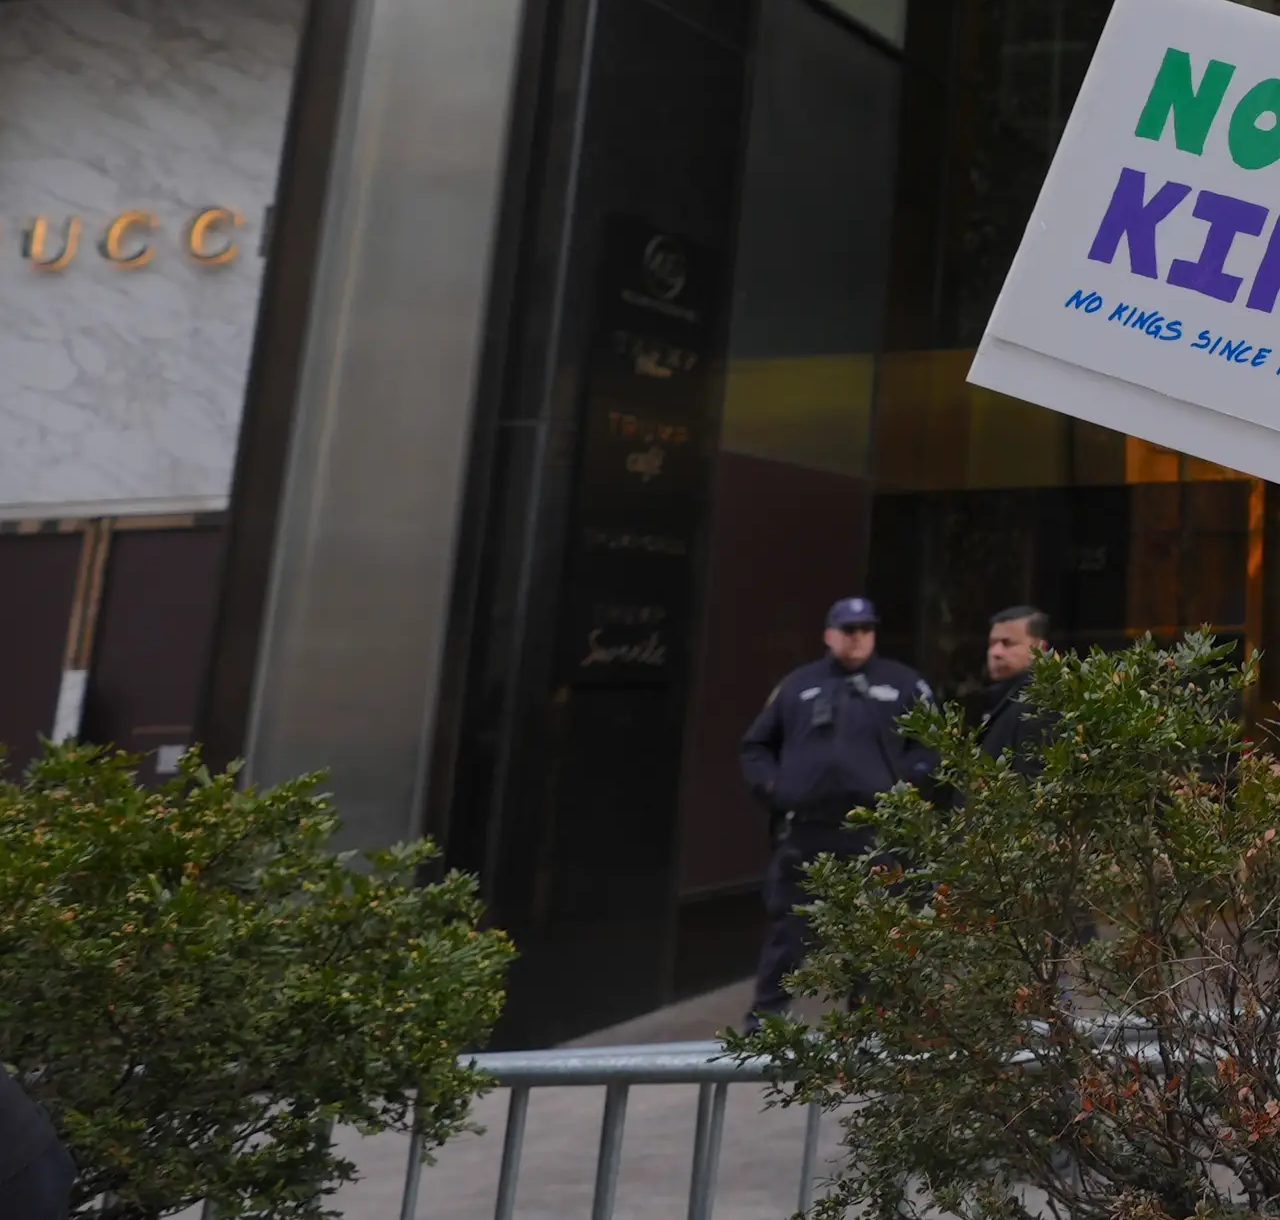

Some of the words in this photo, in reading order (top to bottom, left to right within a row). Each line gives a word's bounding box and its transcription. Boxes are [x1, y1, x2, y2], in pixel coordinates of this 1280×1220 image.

[1064, 288, 1102, 315] NO
[1108, 303, 1182, 342] KINGS
[1190, 328, 1273, 368] SINCE
